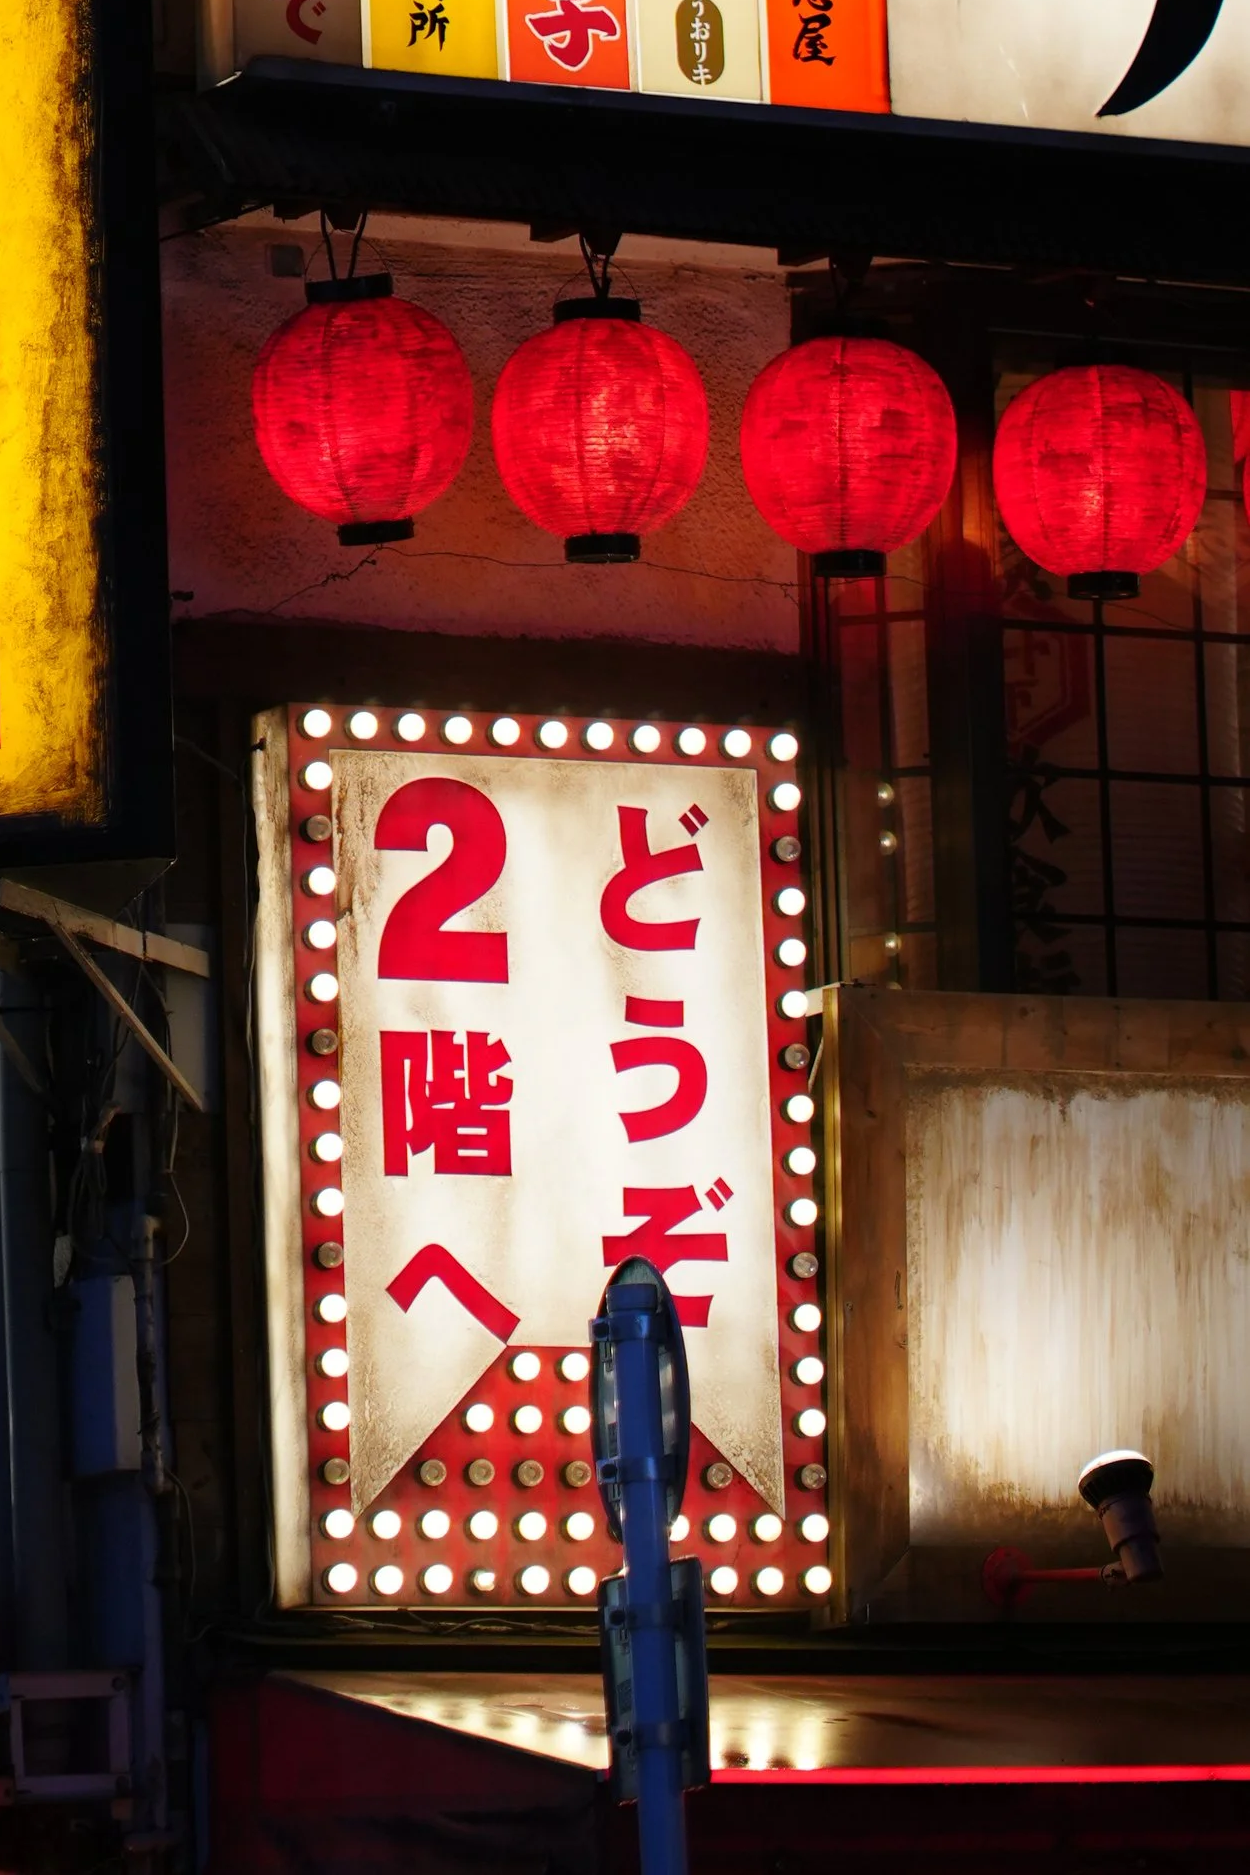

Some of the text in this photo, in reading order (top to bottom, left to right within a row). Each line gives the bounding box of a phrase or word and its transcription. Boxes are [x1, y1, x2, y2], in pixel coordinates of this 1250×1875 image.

[373, 777, 521, 1343] 2階へ
[599, 803, 734, 1329] どうぞ
